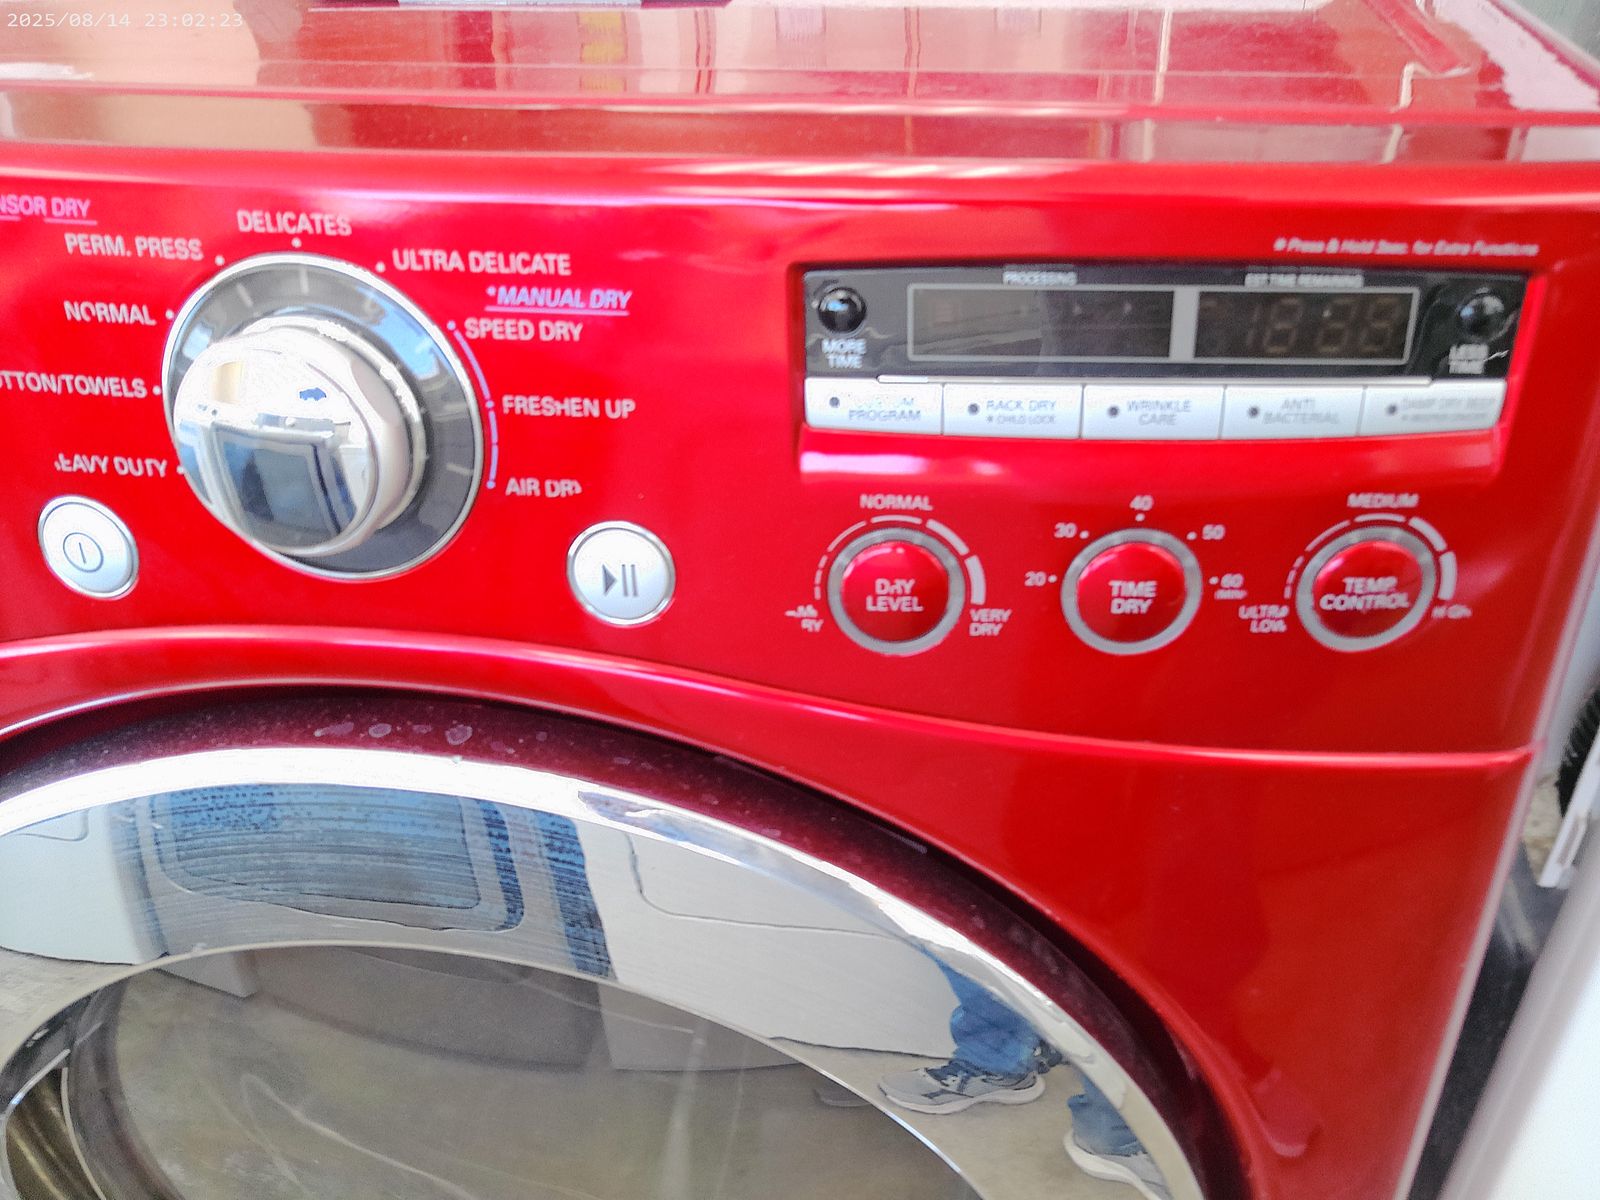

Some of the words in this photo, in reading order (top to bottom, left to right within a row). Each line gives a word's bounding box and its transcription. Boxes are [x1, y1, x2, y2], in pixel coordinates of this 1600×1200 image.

[51, 196, 91, 218] DRY
[236, 210, 352, 236] DELICATES
[64, 232, 132, 257] PERM.
[135, 236, 204, 261] PRESS
[392, 248, 464, 273] ULTRA
[468, 250, 572, 276] DELICATE
[590, 289, 632, 310] DRY
[63, 301, 156, 326] NORMAL
[464, 317, 535, 341] SPEED
[539, 320, 583, 342] DRY
[827, 353, 863, 369] TIME
[502, 394, 600, 418] FRESHEN
[604, 399, 636, 419] UP
[986, 398, 1024, 412] RACK
[1028, 400, 1056, 412] DRY
[1127, 400, 1192, 413] WRINKLE
[848, 408, 921, 422] PROGRAM
[1138, 413, 1177, 426] CARE
[113, 456, 168, 478] DUTY
[505, 477, 541, 497] AIR
[859, 494, 933, 511] NORMAL
[1129, 495, 1154, 511] 40
[1347, 493, 1420, 509] MEDIUM
[1054, 523, 1077, 538] 30
[1201, 524, 1226, 540] 50
[875, 578, 916, 595] DRY
[1024, 572, 1046, 587] 20
[1220, 573, 1244, 588] 60
[1108, 580, 1158, 598] TIME
[865, 596, 924, 612] LEVEL
[1109, 599, 1152, 615] DRY
[1319, 594, 1410, 612] CONTROL
[969, 608, 1012, 623] VERY
[969, 623, 1004, 637] DRY
